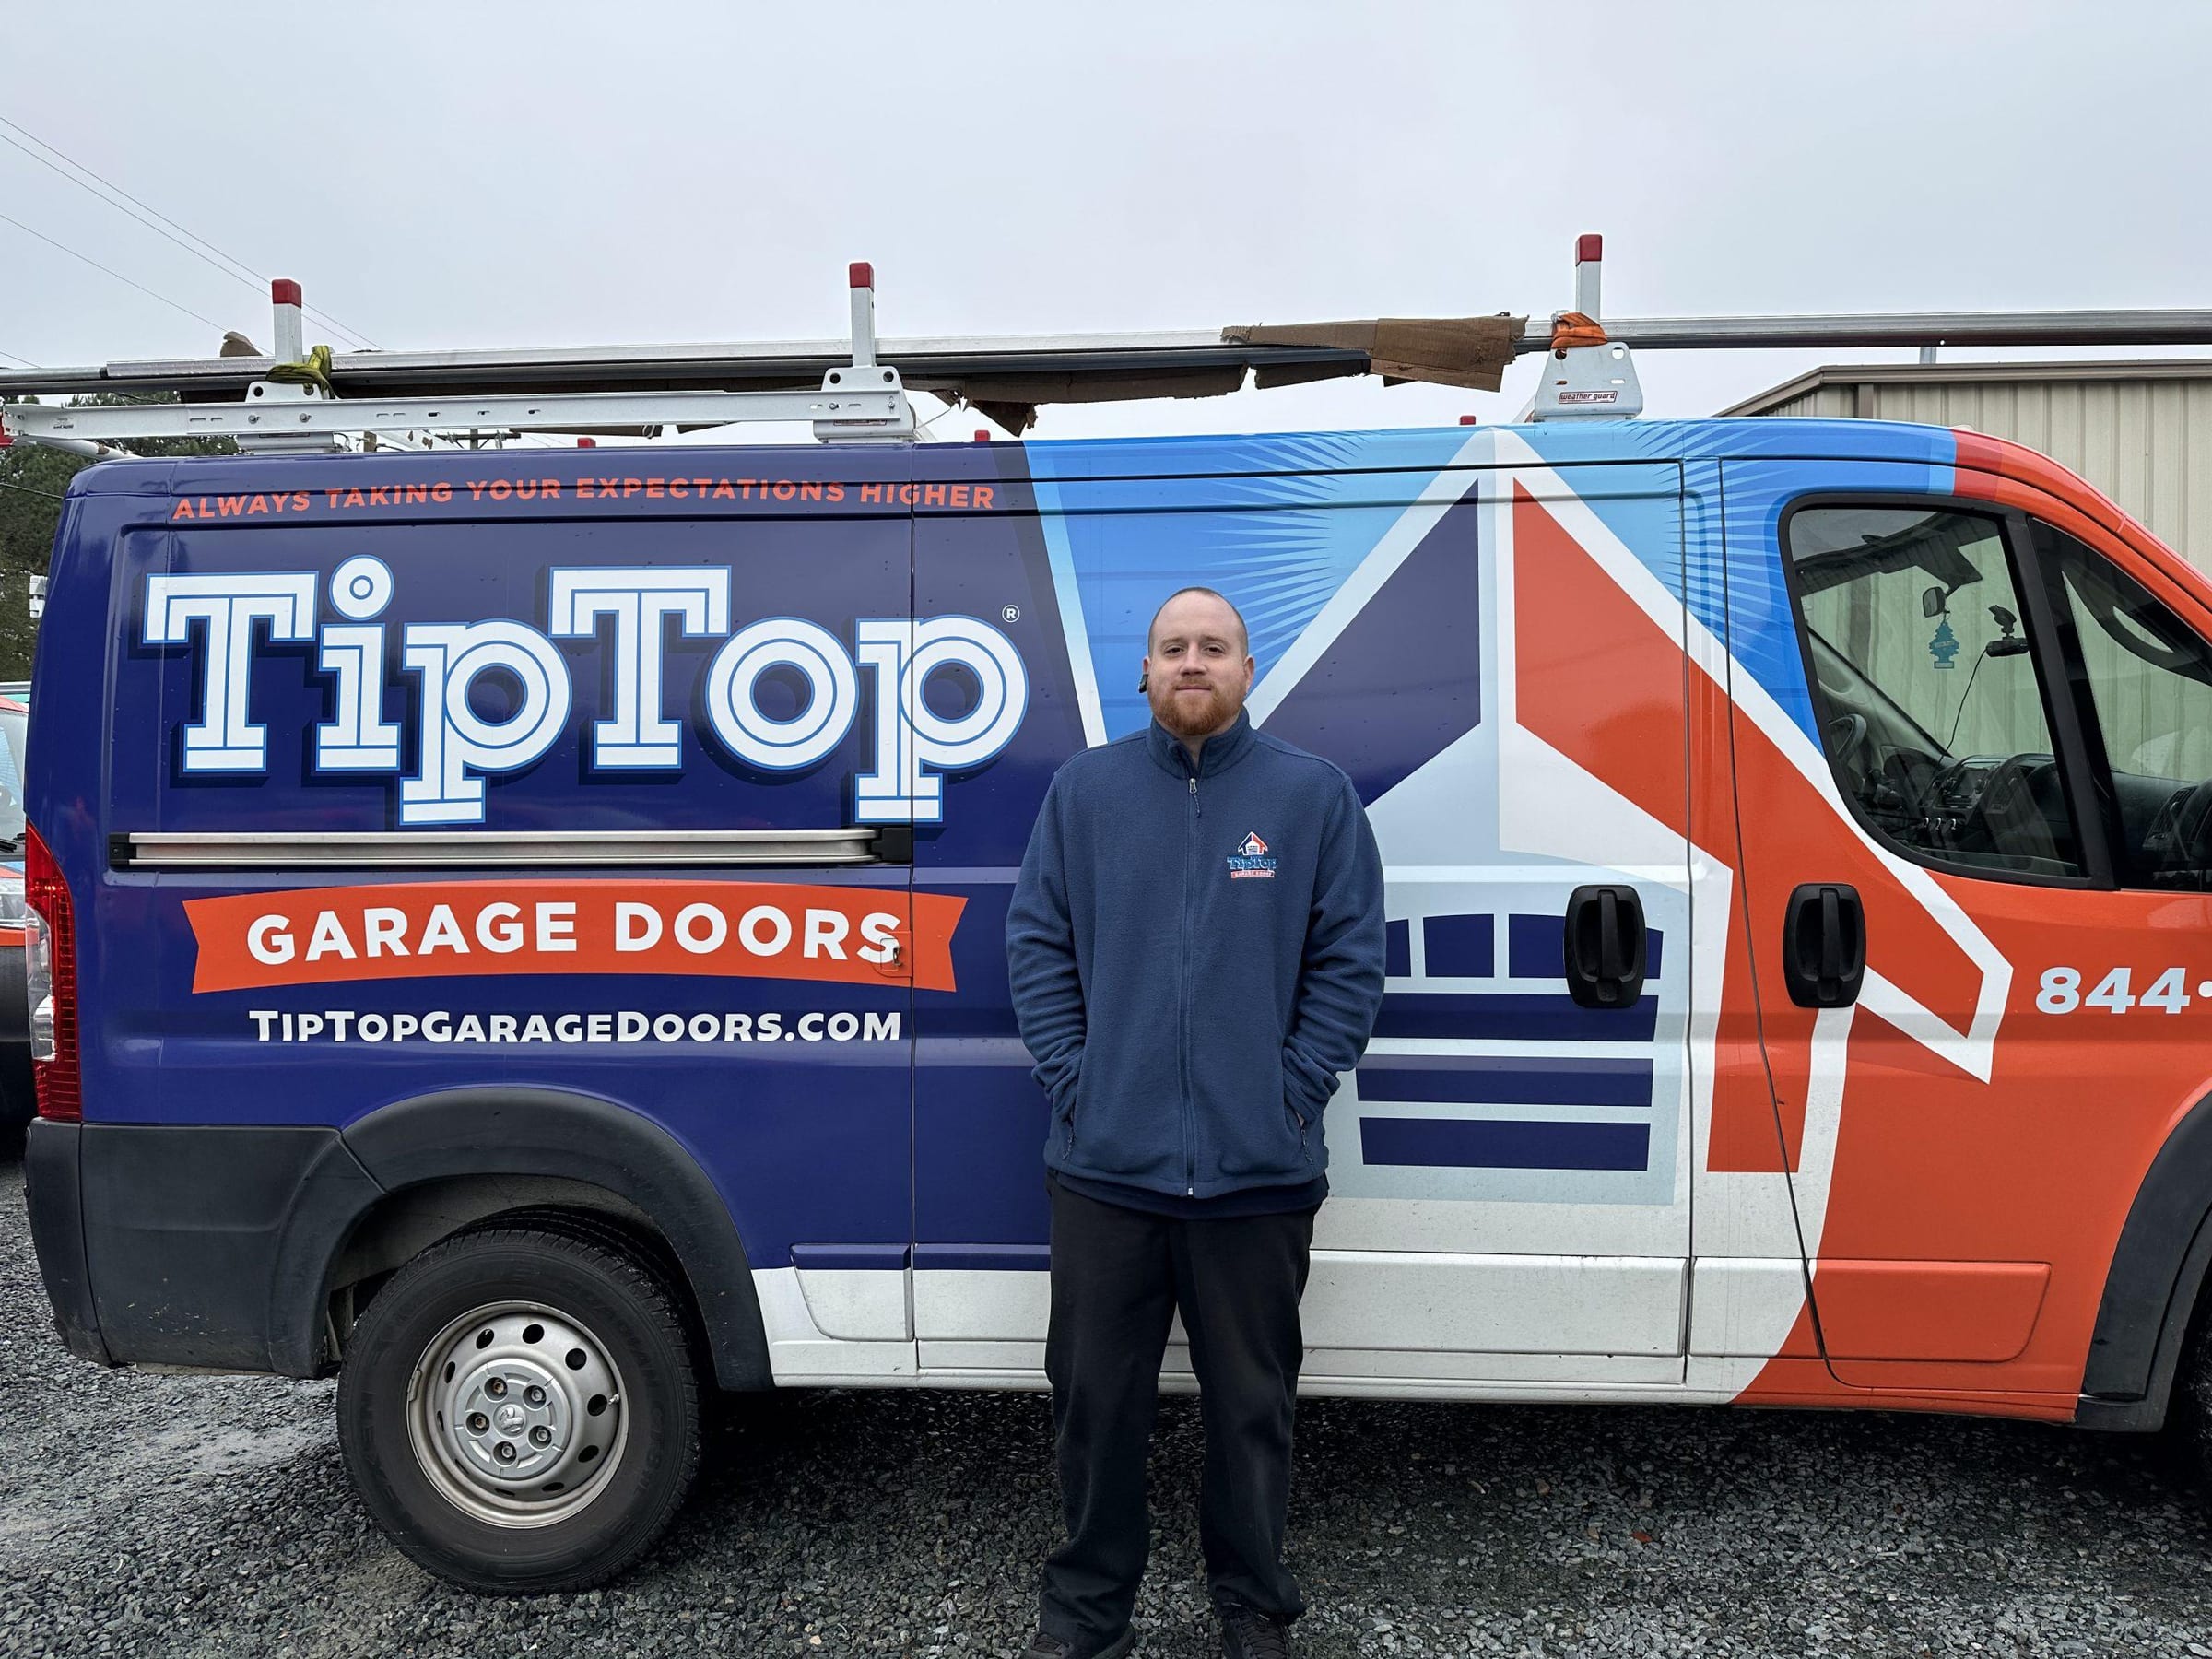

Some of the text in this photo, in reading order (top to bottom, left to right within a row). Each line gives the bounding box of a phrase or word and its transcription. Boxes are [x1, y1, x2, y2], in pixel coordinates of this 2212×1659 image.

[1594, 392, 1616, 401] guard
[172, 477, 994, 520] ALWAYS TAKING YOUR EXPECTATIONS HIGHER
[246, 901, 902, 966] GARAGE DOORS
